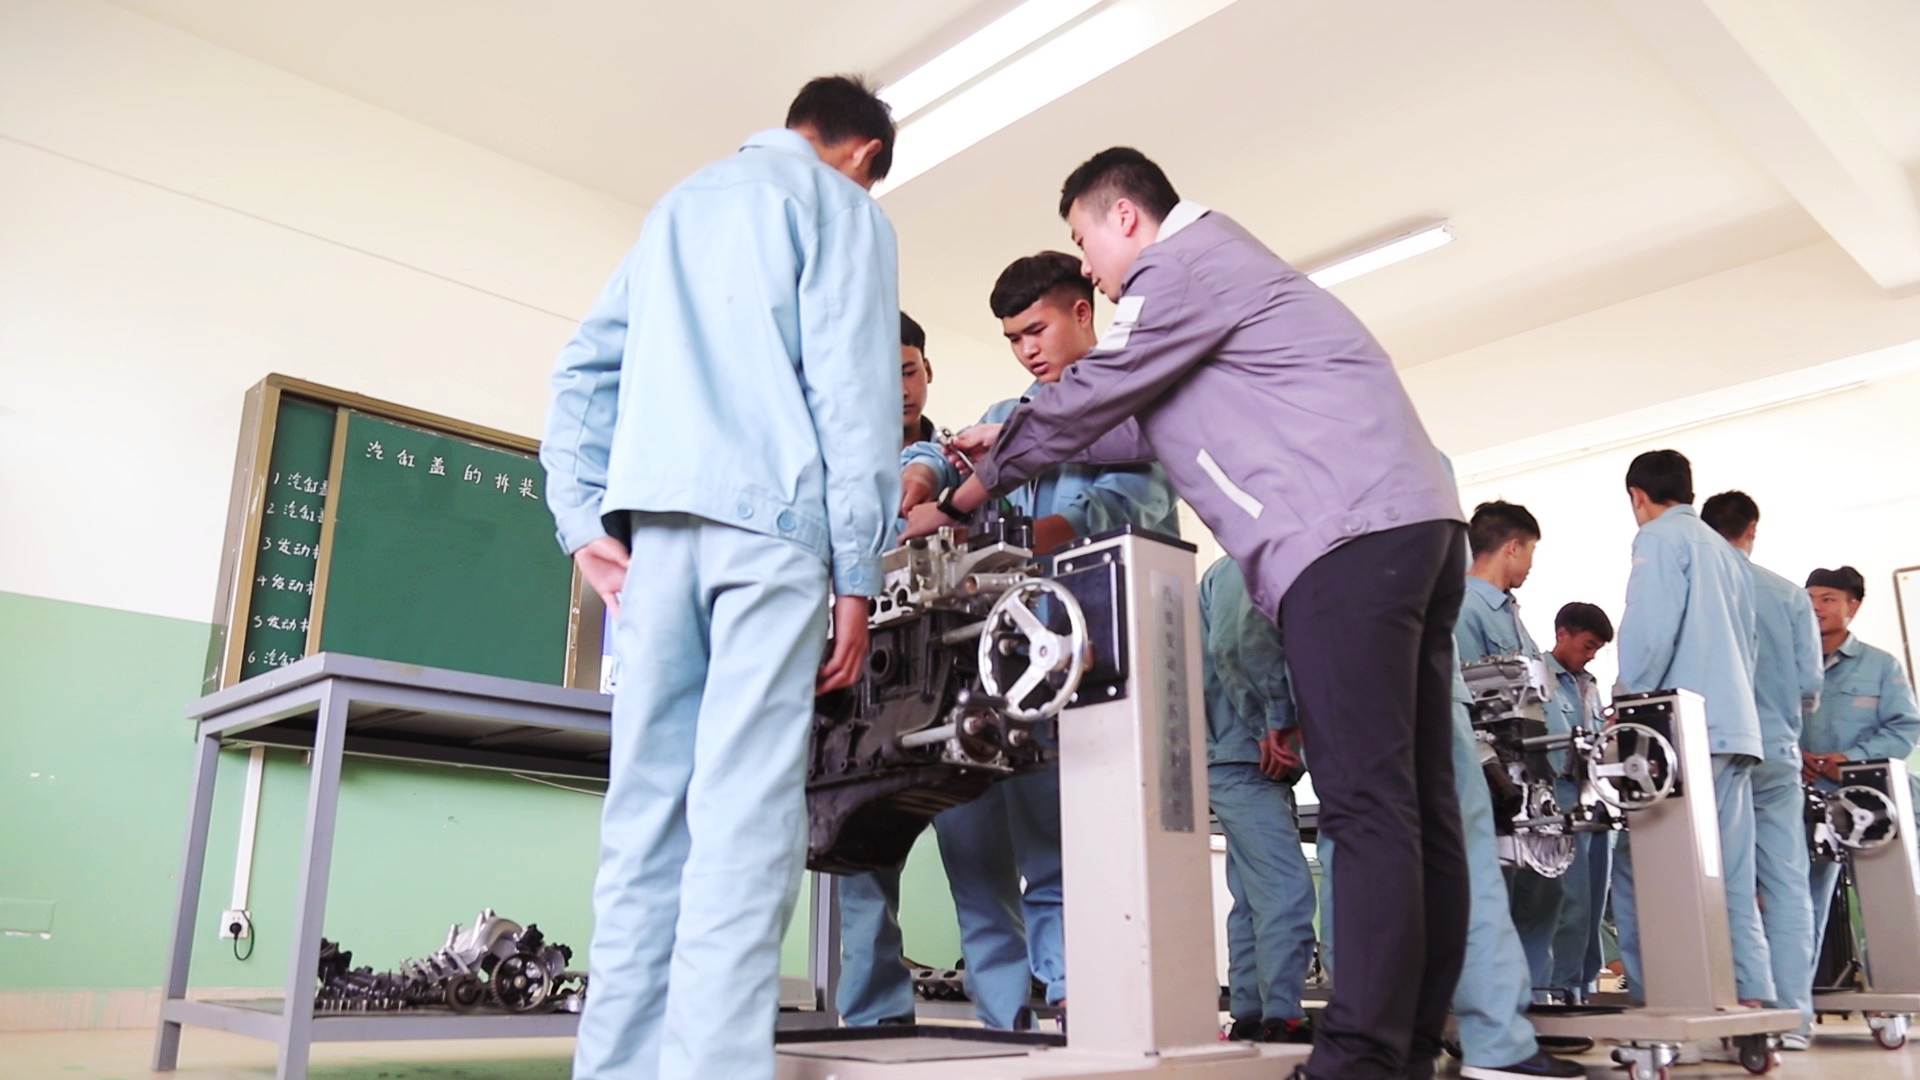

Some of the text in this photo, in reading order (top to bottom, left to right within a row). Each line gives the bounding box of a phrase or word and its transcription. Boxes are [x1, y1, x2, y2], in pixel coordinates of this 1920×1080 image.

[274, 472, 280, 485] 1
[266, 502, 275, 514] 2
[263, 537, 272, 550] 3
[257, 575, 267, 587] 4
[254, 615, 263, 628] 5
[247, 649, 304, 666] 6 汽缸
